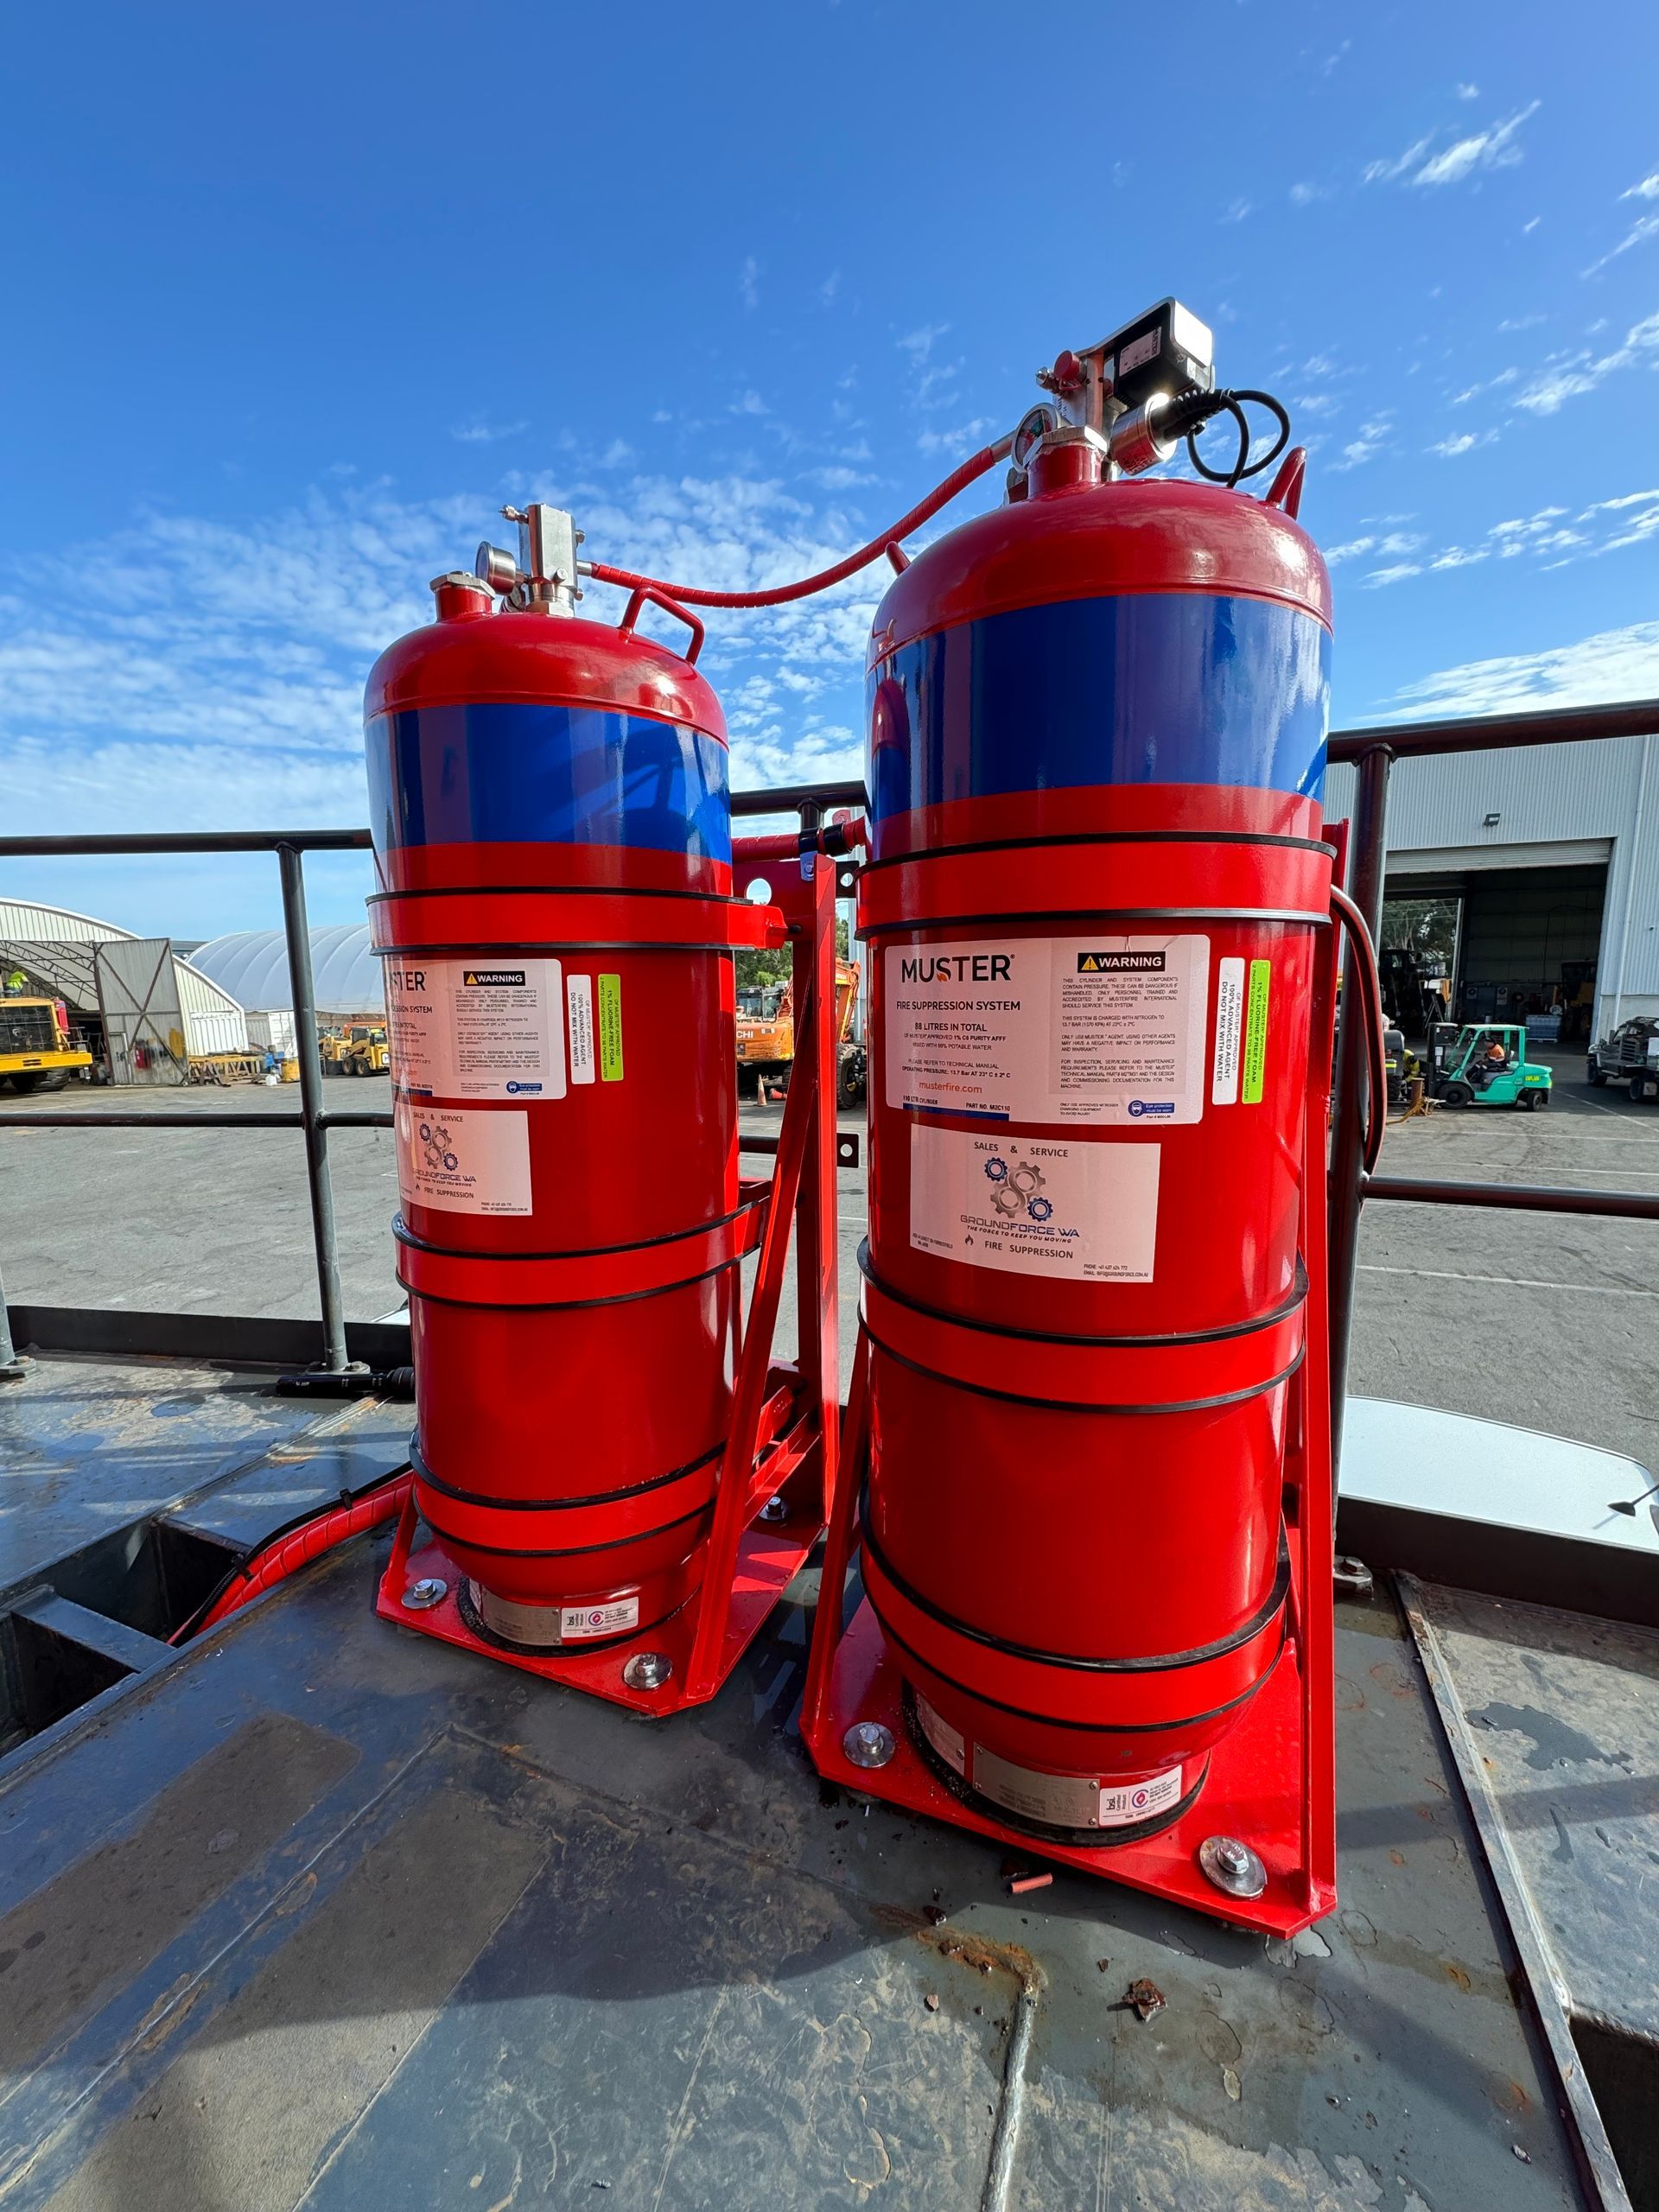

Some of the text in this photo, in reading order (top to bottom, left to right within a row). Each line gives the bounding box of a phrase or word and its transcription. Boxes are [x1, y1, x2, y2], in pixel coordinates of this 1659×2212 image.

[1098, 957, 1162, 968] WARNING
[1222, 982, 1228, 994] DO
[1257, 982, 1262, 992] 1%
[1236, 993, 1241, 1001] OF
[897, 1001, 1020, 1010] FIRE SUPPRESSION SYSTEM
[924, 1022, 949, 1031] LITRES
[960, 1023, 988, 1032] TOTAL
[1253, 995, 1262, 1058] FLUORINE-FREE
[1248, 1039, 1253, 1047] TO
[918, 1081, 982, 1094] musterfire.com
[974, 1141, 1069, 1158] SALES & SERVICE
[436, 1189, 474, 1198] SUPPRESSION
[960, 1214, 1079, 1237] GROUNDFORCE WA
[984, 1241, 1073, 1259] FIRE SUPPRESSION
